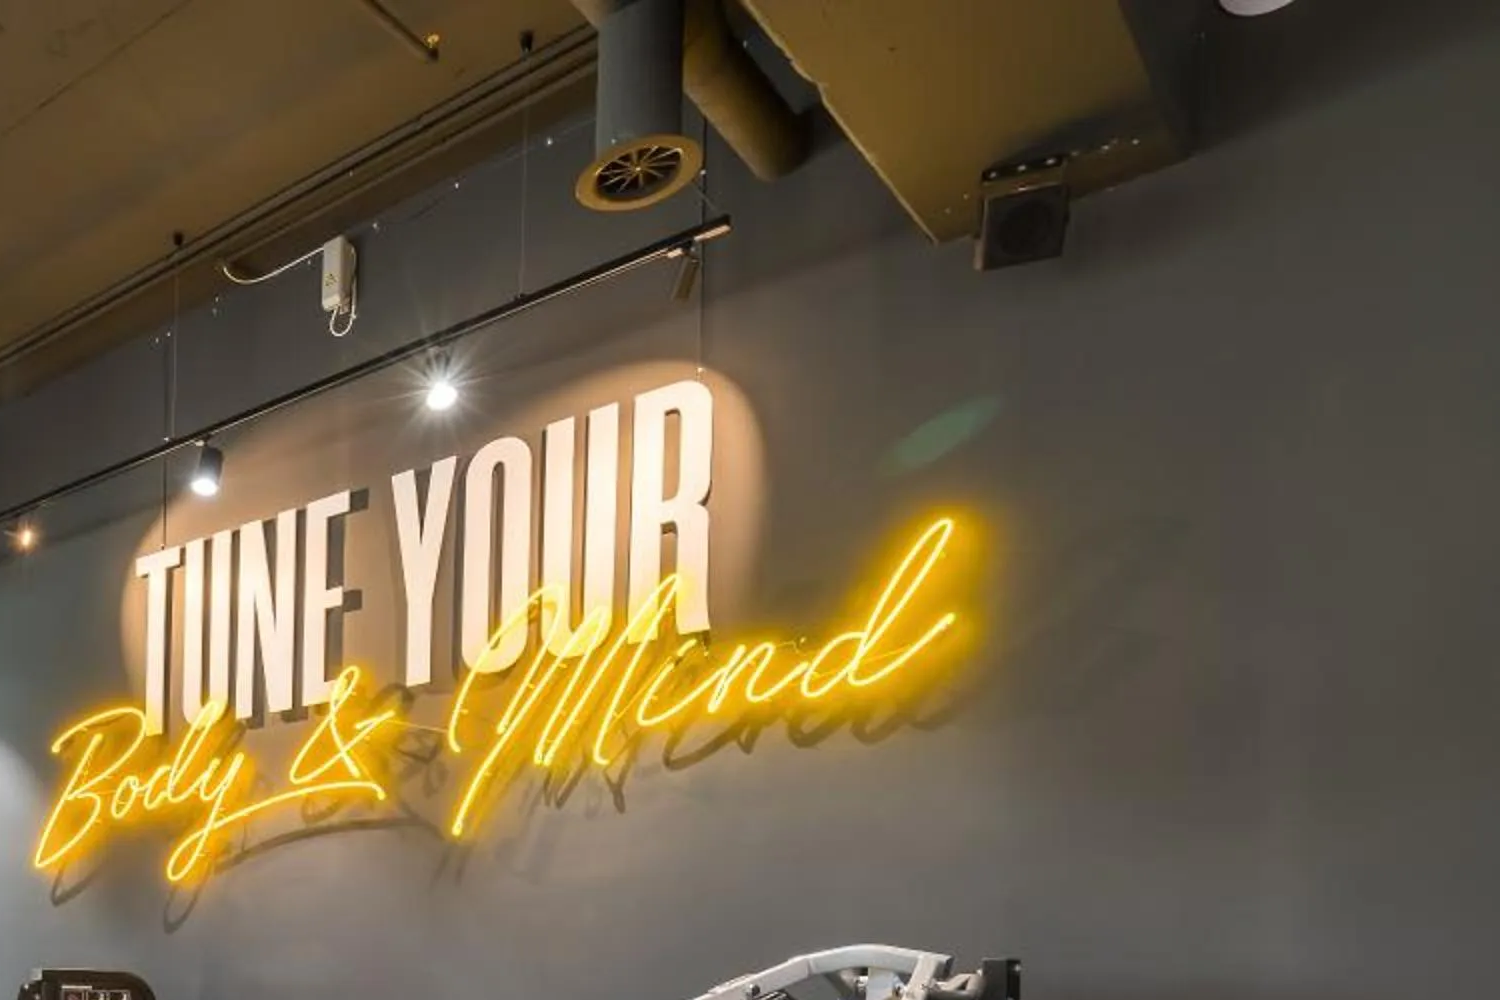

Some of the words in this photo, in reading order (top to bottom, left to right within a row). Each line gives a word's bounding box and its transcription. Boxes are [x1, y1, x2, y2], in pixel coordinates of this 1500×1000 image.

[33, 698, 387, 881] Body
[448, 517, 956, 837] Mind
[136, 489, 350, 737] TUNE
[390, 378, 713, 688] YOUR
